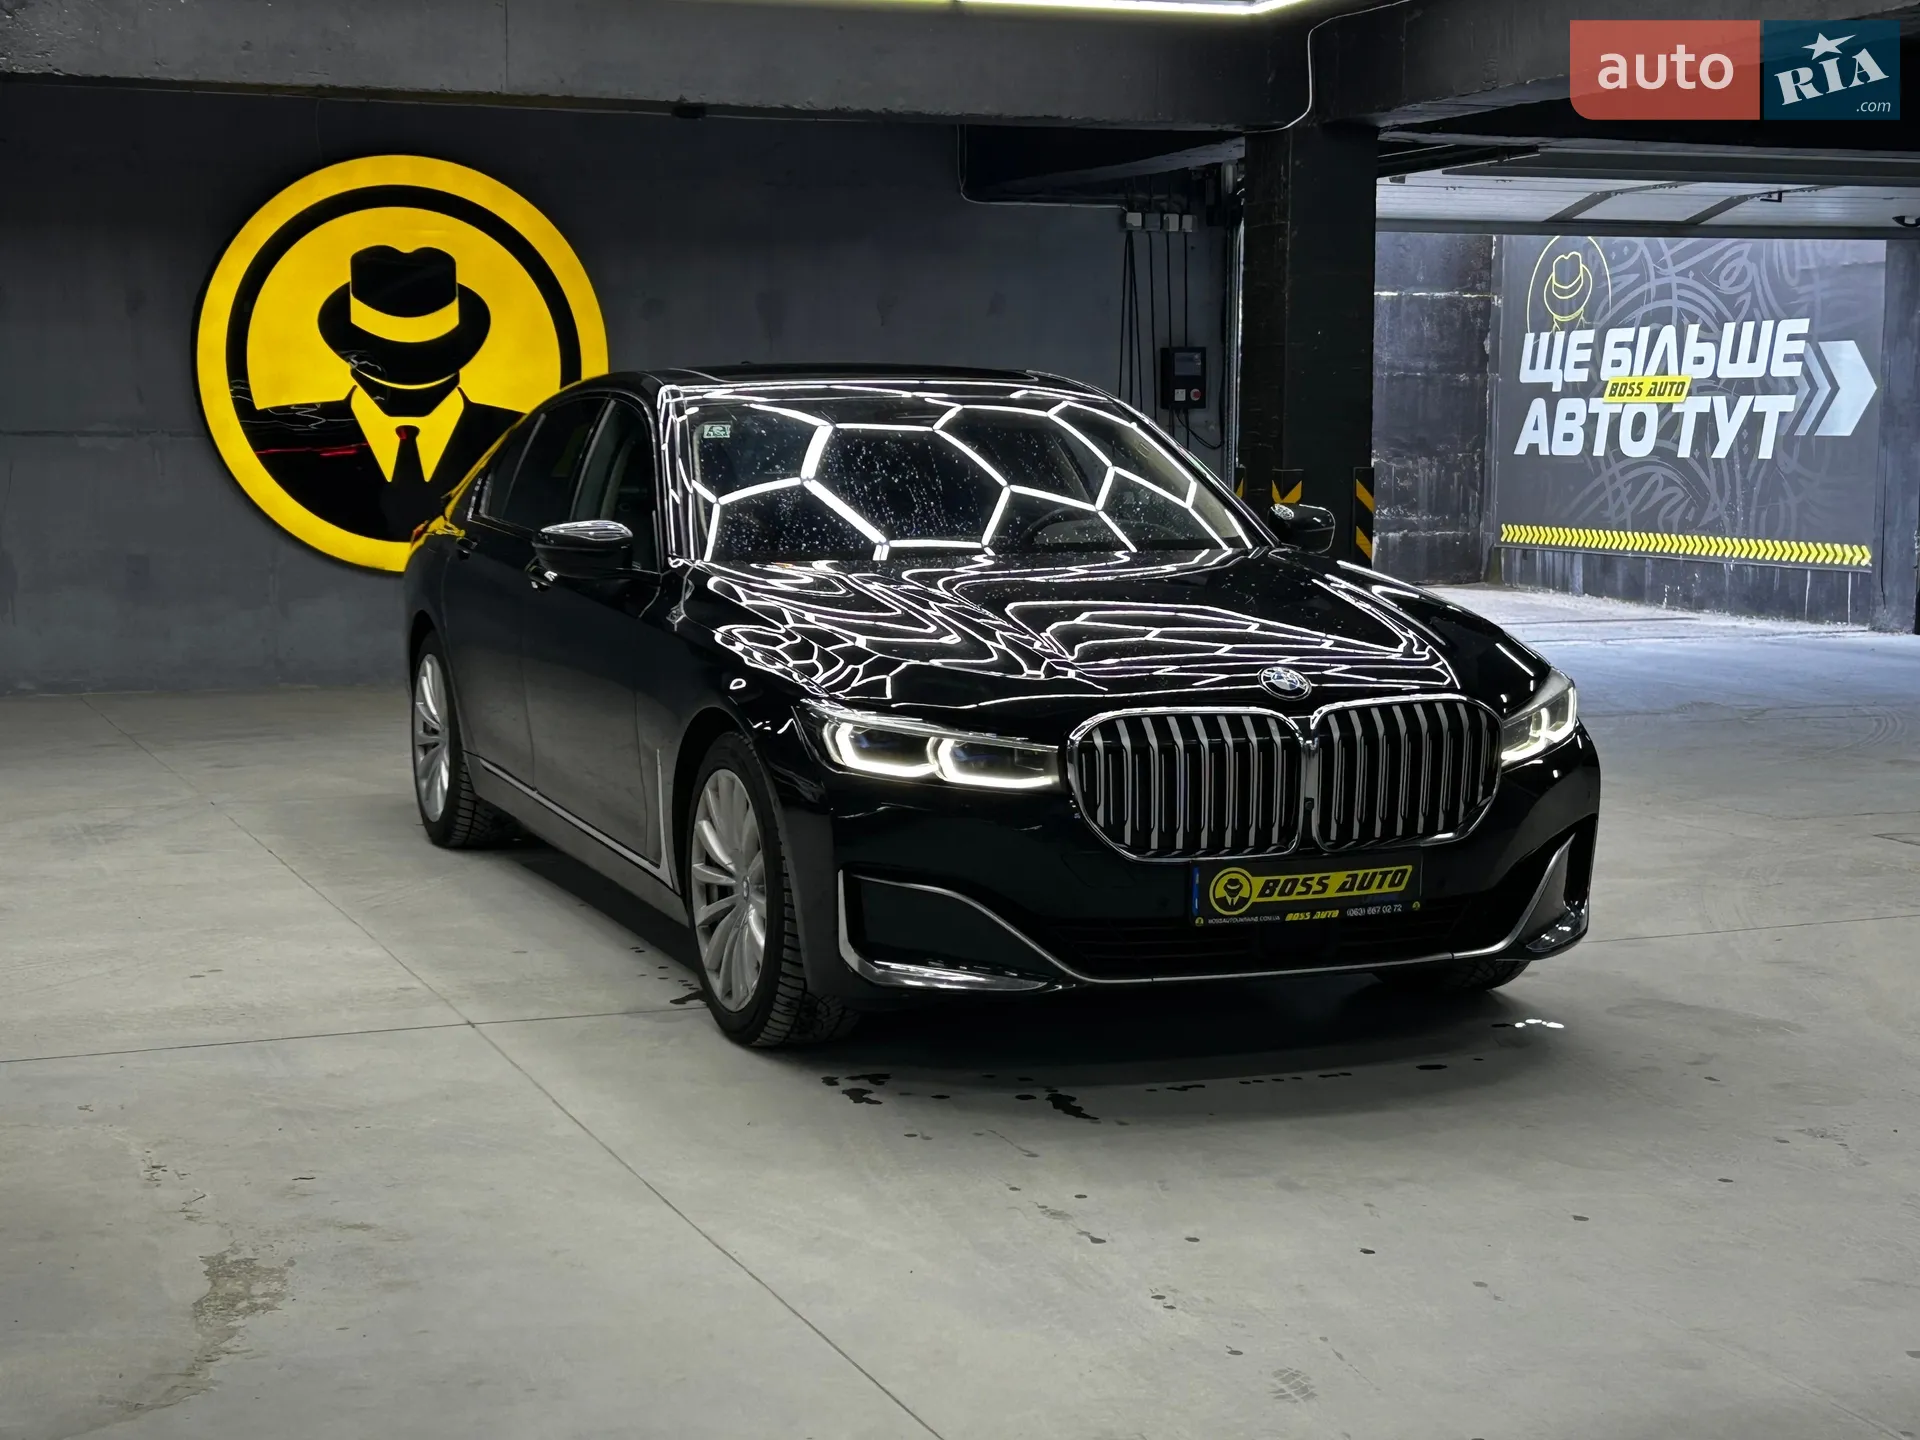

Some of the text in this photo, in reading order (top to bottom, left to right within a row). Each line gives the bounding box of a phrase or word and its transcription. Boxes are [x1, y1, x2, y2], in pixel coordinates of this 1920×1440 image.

[1519, 318, 1810, 392] ЩЕ БІЛЬШЕ
[1608, 379, 1687, 398] BOSS AUTO
[1514, 394, 1797, 459] АВТО ТУТ
[1256, 868, 1410, 899] BOSS AUTO
[1285, 909, 1339, 921] BOSS AUTO
